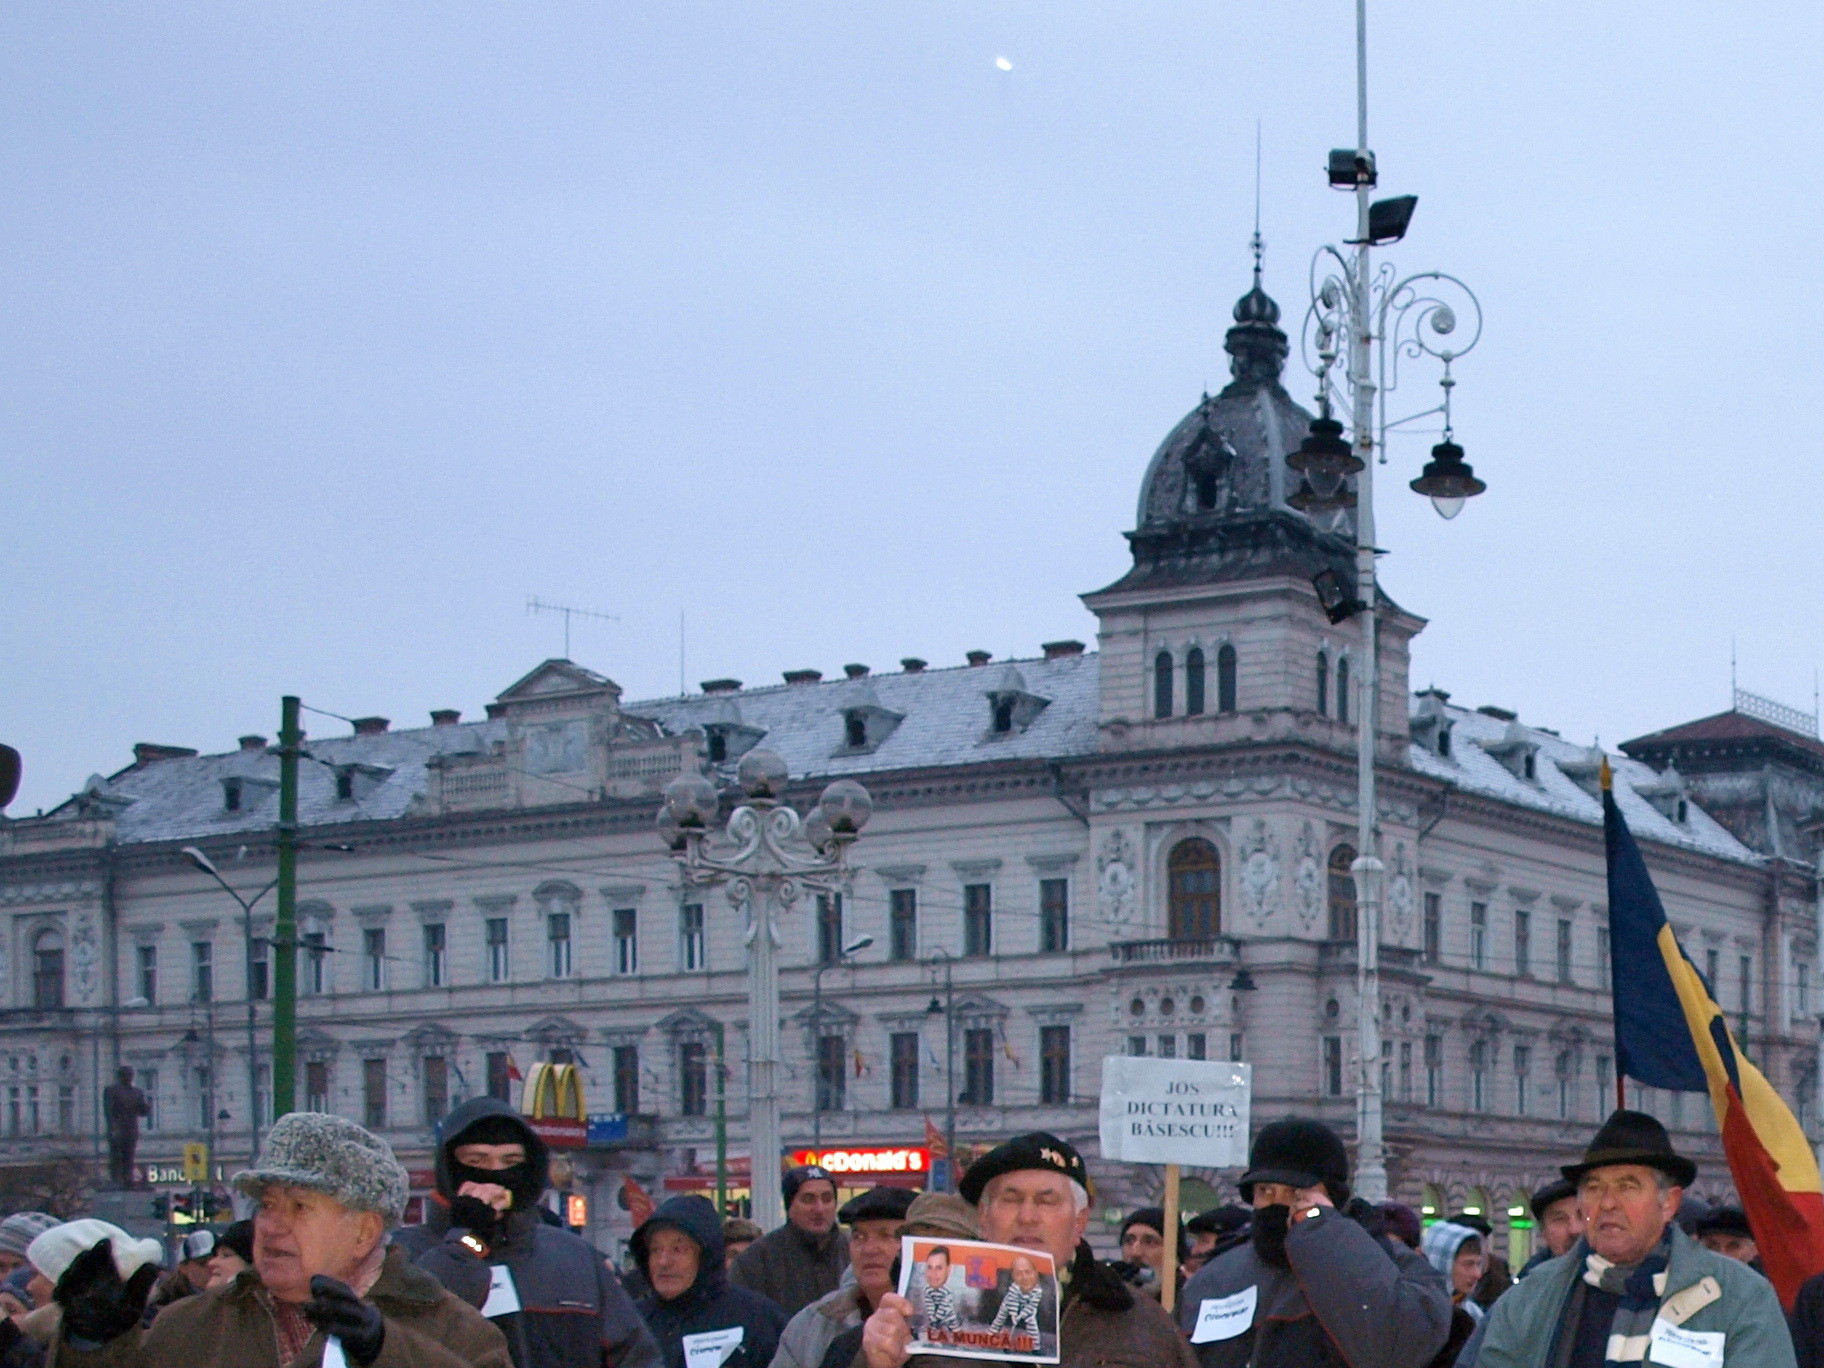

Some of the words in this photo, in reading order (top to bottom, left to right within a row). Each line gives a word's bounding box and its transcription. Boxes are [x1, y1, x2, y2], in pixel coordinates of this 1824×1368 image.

[1165, 1081, 1200, 1096] JOS
[1127, 1101, 1239, 1118] DICTATURA
[1131, 1120, 1235, 1139] BĂSESCU!!!
